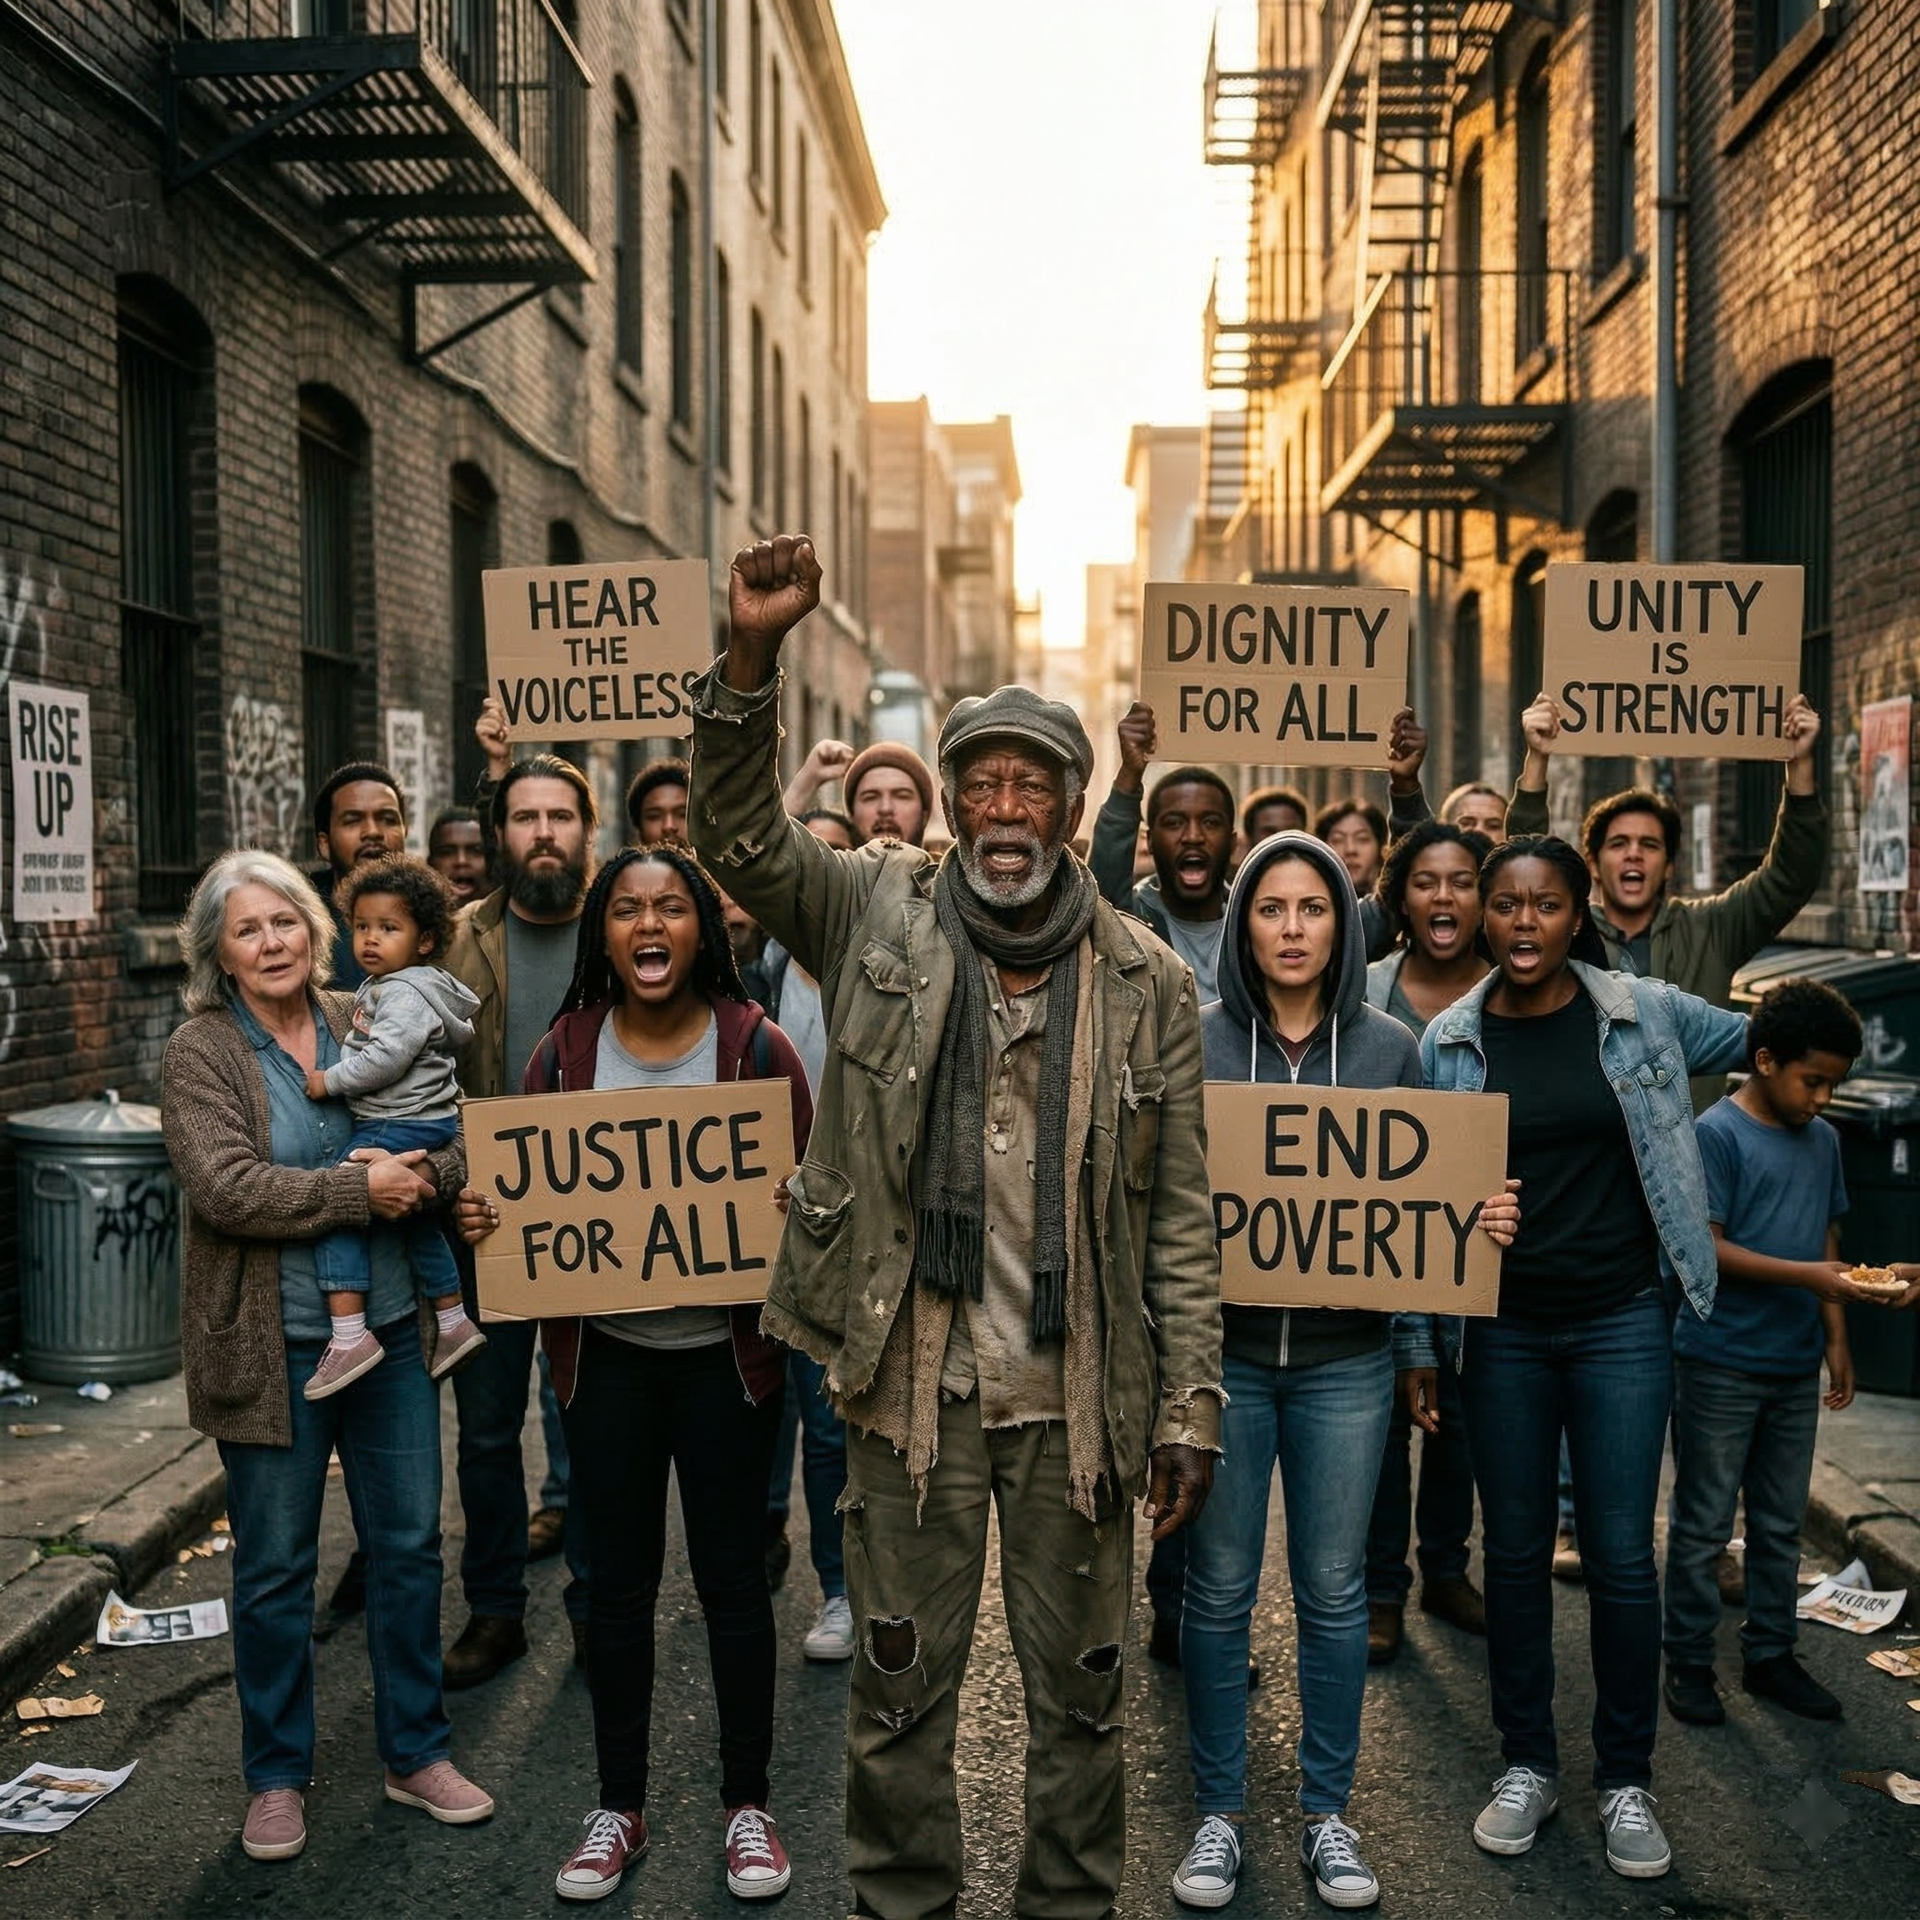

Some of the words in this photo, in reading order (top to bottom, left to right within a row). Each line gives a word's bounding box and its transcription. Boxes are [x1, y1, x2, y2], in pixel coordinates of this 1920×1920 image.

[529, 577, 660, 630] HEAR
[1167, 603, 1390, 668] DIGNITY
[1588, 579, 1763, 635] UNITY
[563, 636, 628, 666] THE
[1652, 642, 1689, 675] IS
[18, 699, 82, 766] RISE
[1179, 686, 1260, 733] FOR
[1276, 683, 1377, 742] ALL
[1559, 681, 1783, 738] STRENGTH
[34, 770, 73, 837] UP
[494, 1110, 768, 1201] JUSTICE
[1265, 1104, 1429, 1181] END
[521, 1218, 623, 1281] FOR
[641, 1201, 766, 1281] ALL
[1212, 1192, 1486, 1286] POVERTY
